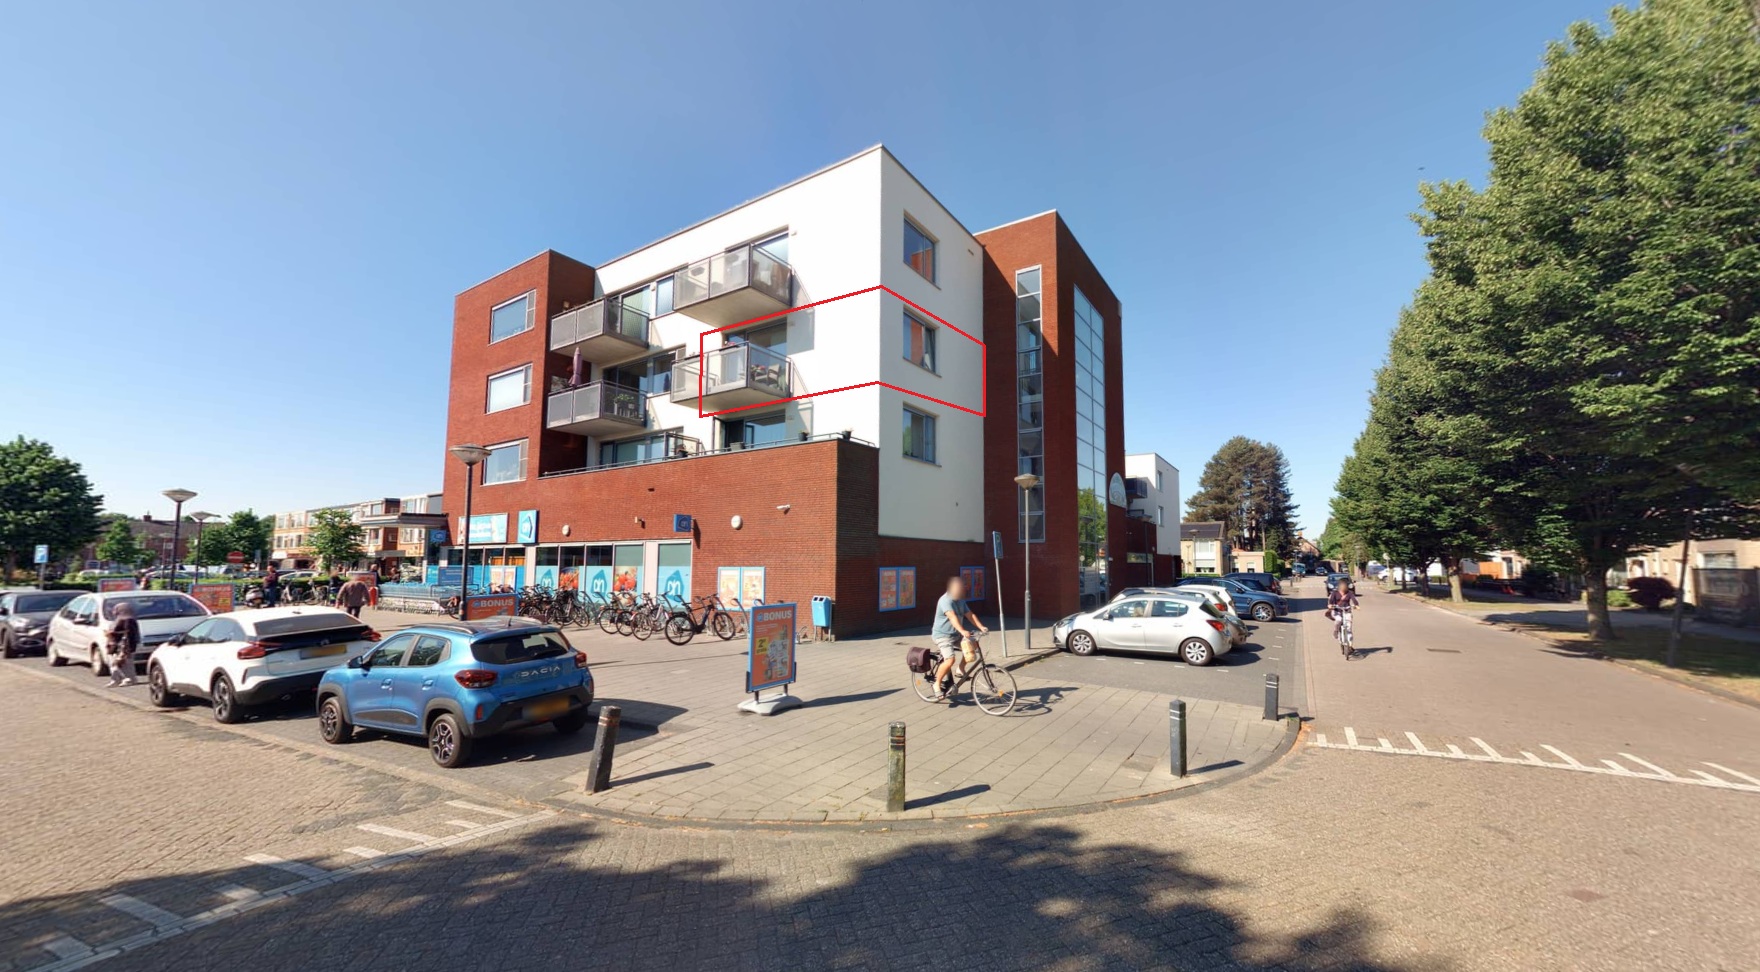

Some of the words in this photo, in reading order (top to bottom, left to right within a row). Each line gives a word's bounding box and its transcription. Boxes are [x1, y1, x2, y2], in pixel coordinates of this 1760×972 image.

[480, 599, 514, 608] BONUS
[763, 609, 792, 621] BONUS
[520, 666, 560, 677] DACIA
